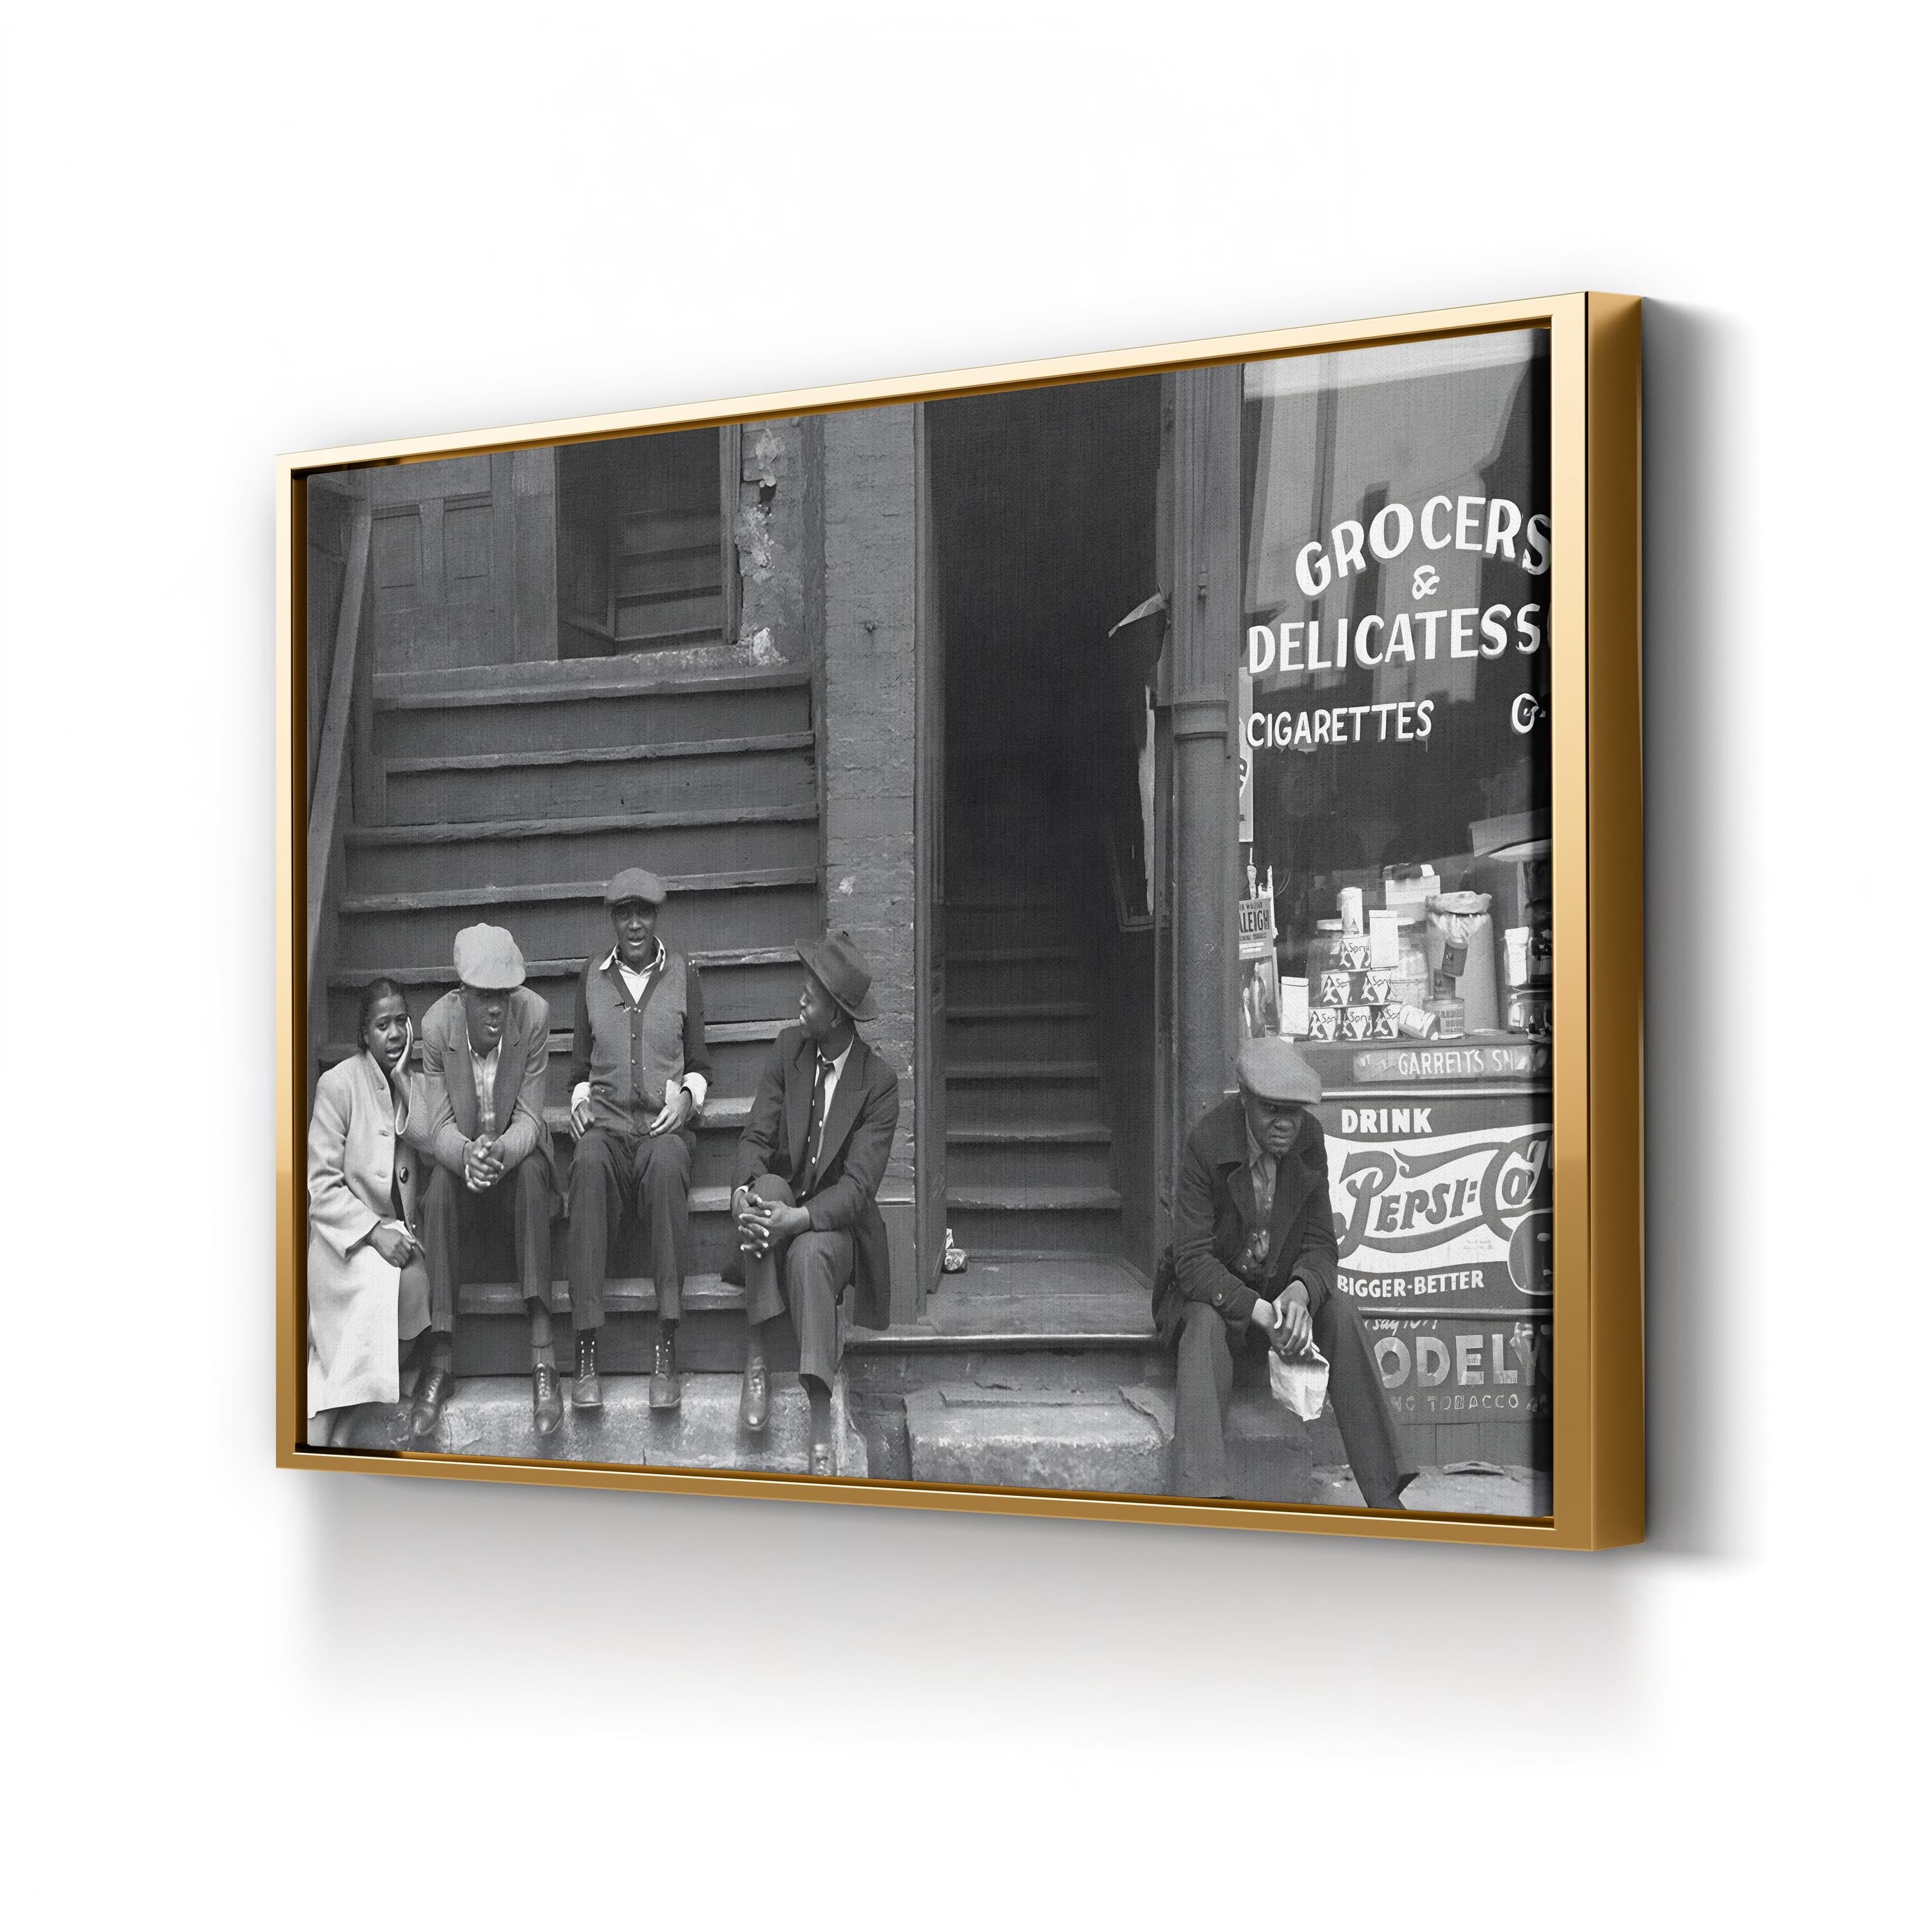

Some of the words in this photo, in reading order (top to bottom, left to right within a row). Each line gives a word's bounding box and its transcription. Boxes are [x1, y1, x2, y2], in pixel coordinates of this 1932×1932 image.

[1412, 565, 1440, 600] &
[1249, 603, 1551, 674] DELICATESS
[1247, 699, 1434, 747] CIGARETTES
[1341, 1108, 1432, 1133] DRINK
[1337, 1270, 1484, 1298] BIGGER-BETTER
